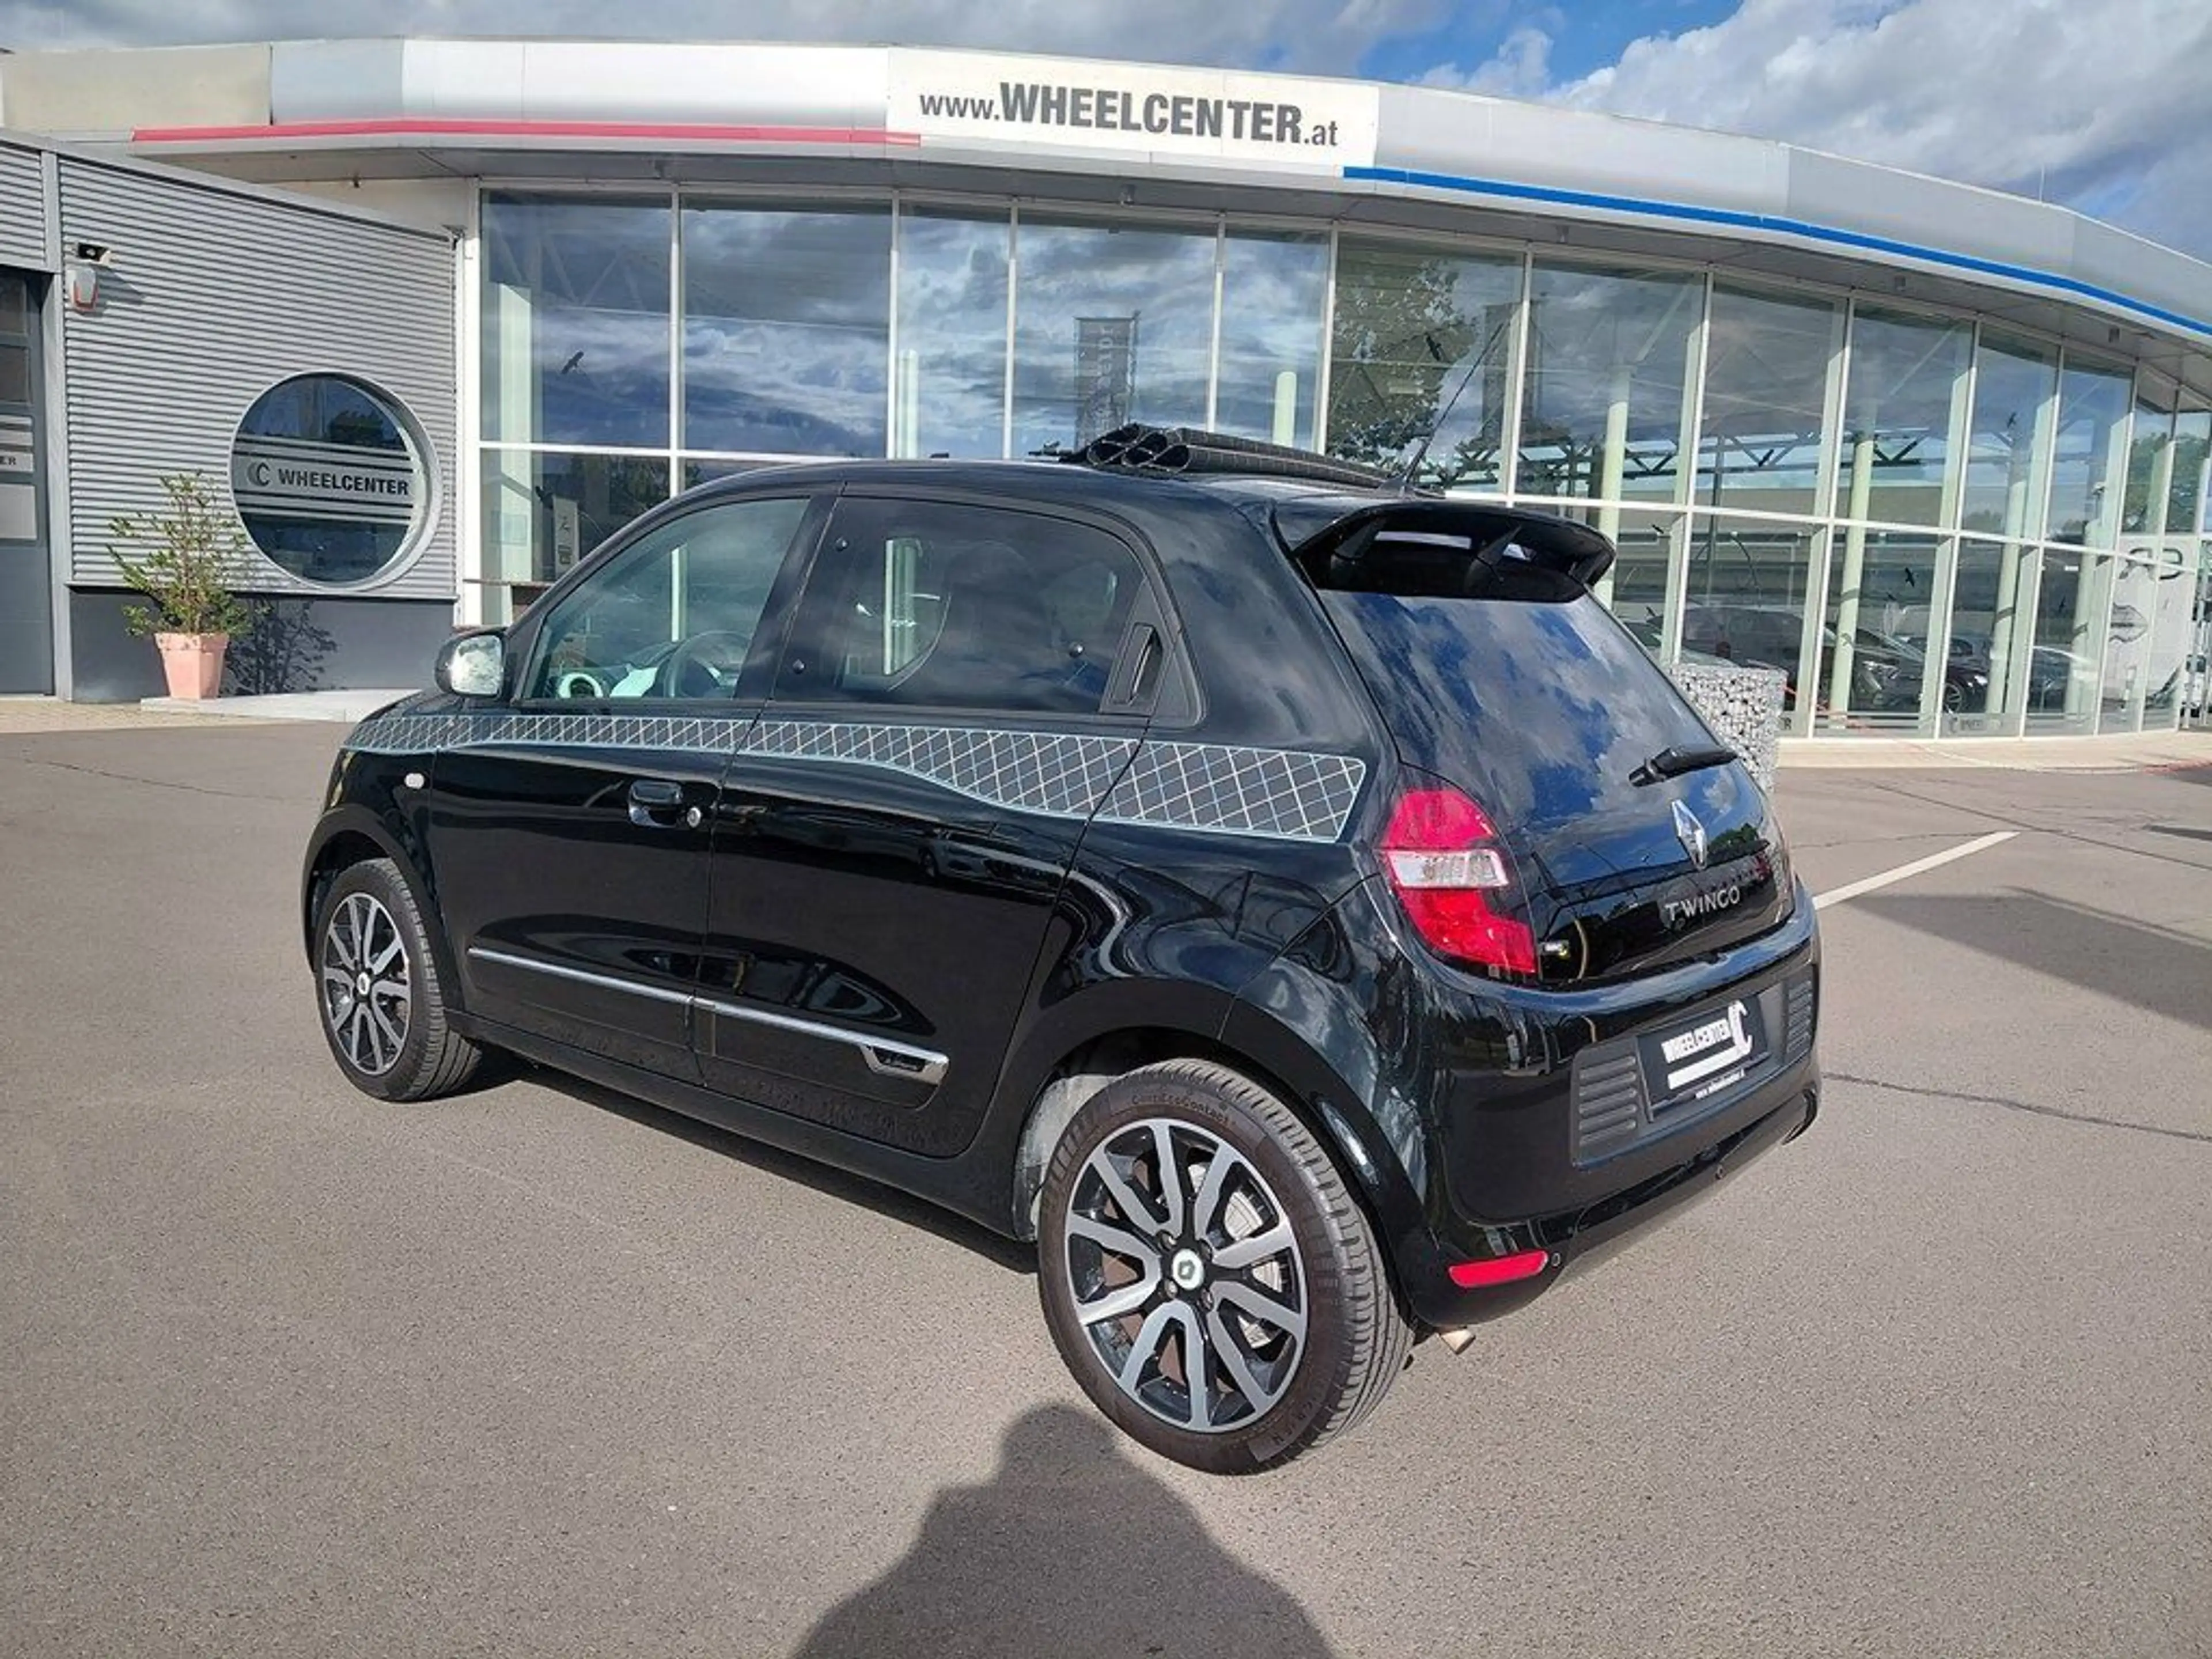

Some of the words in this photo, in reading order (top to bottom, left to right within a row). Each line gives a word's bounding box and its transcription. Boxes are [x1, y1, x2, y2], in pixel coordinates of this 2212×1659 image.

[920, 82, 1338, 146] www.WHEELCENTER.at
[278, 467, 409, 496] WHEELCENTER
[1664, 885, 1740, 921] TWINGO
